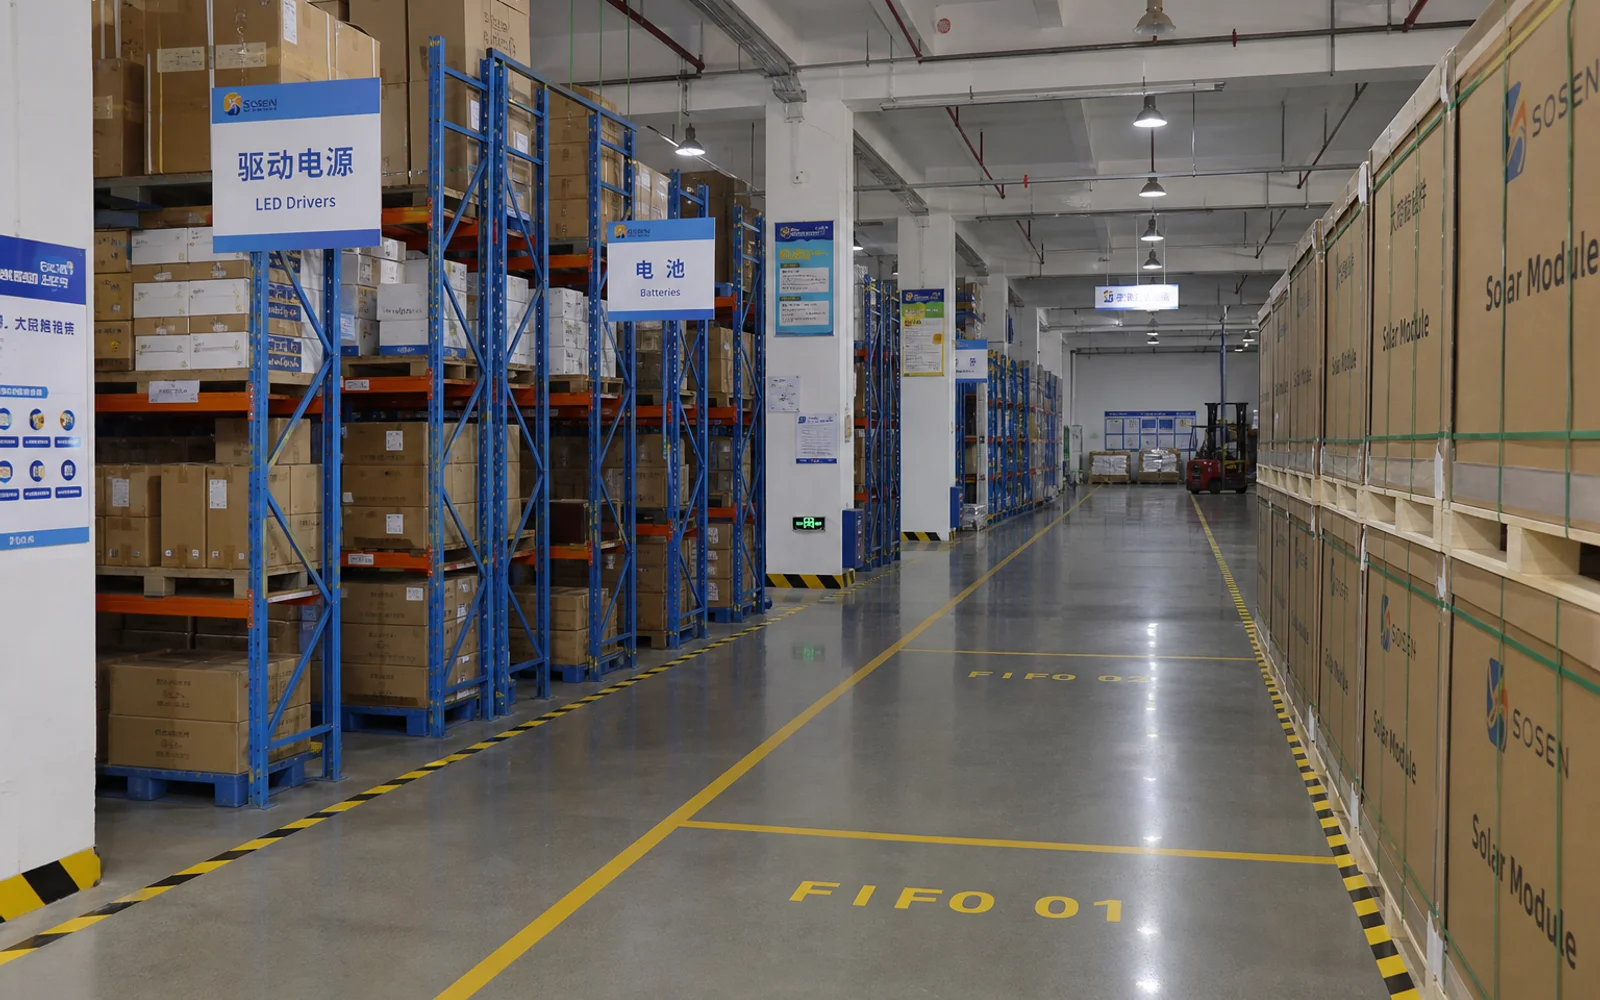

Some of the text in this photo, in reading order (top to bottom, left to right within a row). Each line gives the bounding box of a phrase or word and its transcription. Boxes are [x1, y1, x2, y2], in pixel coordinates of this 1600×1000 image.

[1532, 58, 1599, 138] SOSEN
[238, 146, 354, 182] 驱动电源
[255, 195, 336, 211] LED Drivers
[636, 258, 685, 280] 电池
[1527, 230, 1599, 297] Module
[640, 288, 681, 298] Batteries
[967, 671, 1151, 683] FIFO 02
[1512, 708, 1569, 780] SOSEN
[788, 880, 1123, 923] FIFO 01
[1472, 813, 1577, 970] Solar Module
